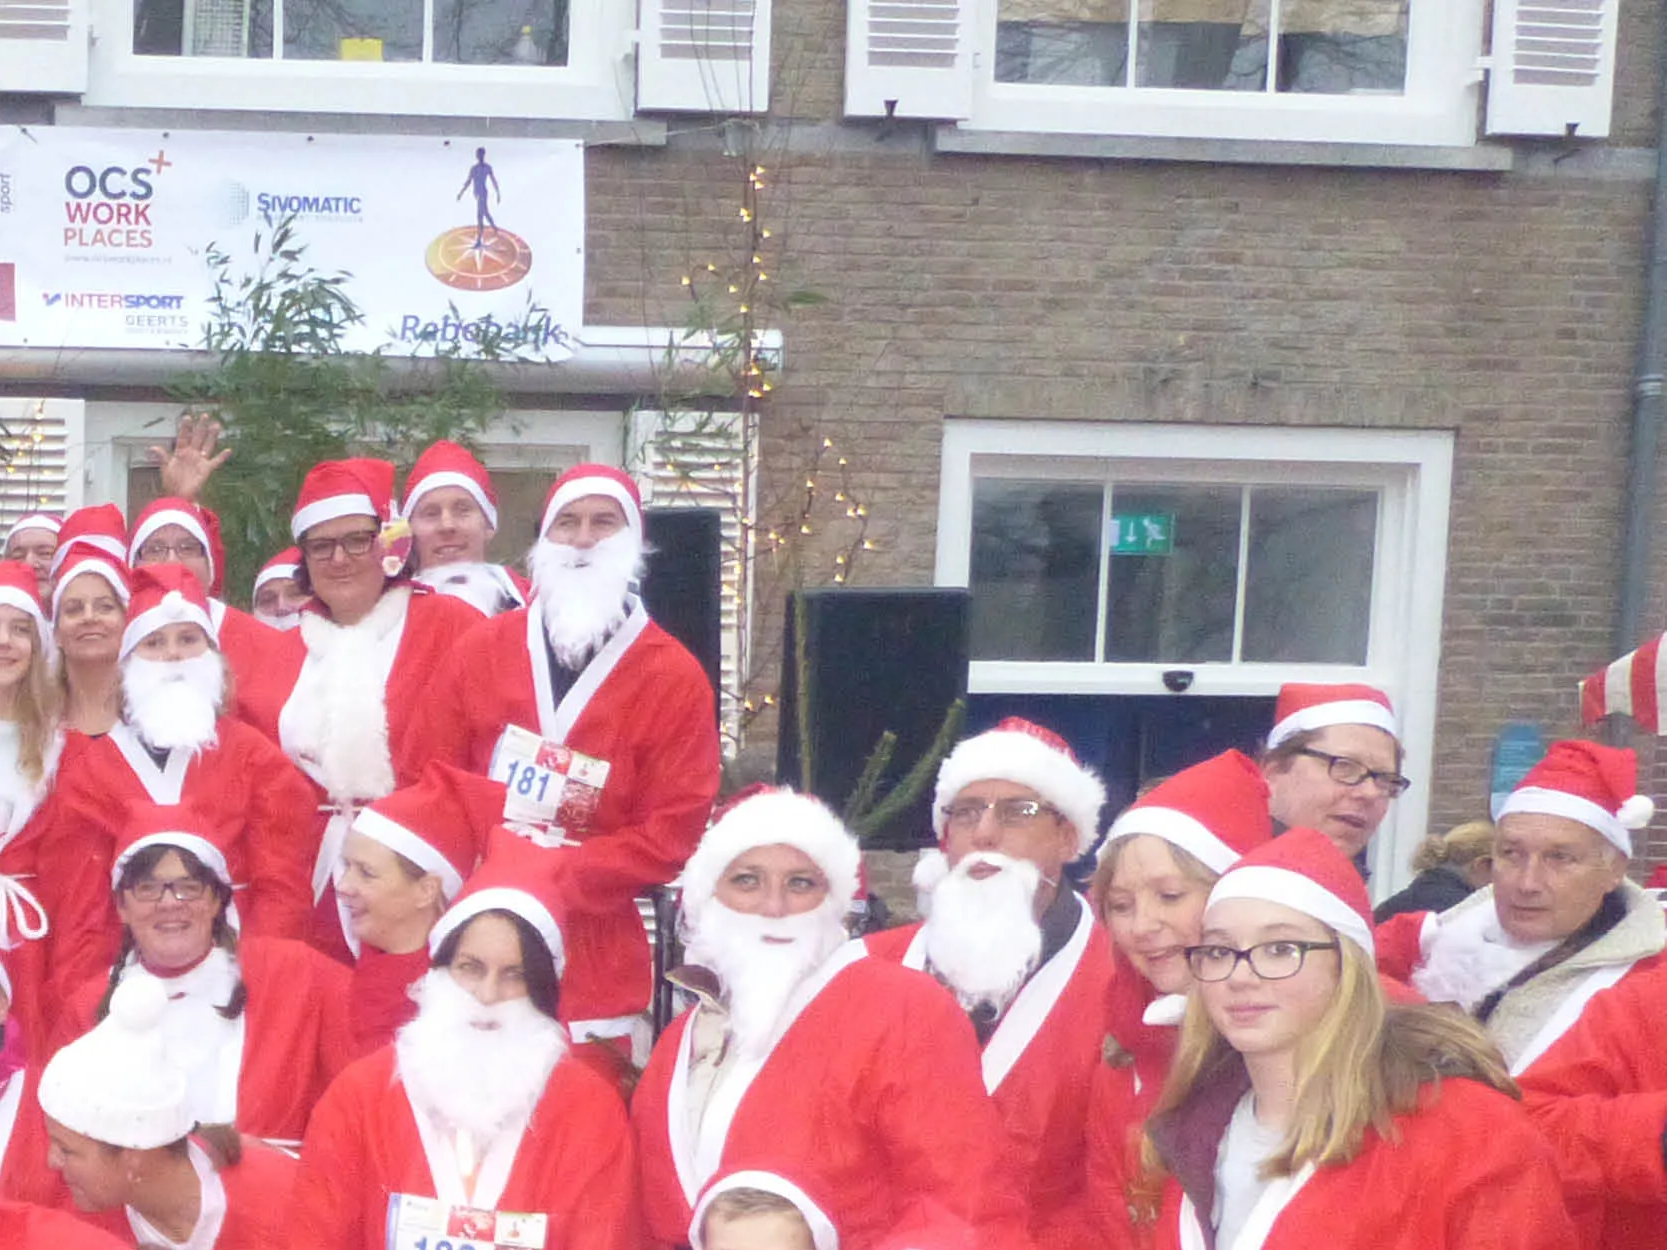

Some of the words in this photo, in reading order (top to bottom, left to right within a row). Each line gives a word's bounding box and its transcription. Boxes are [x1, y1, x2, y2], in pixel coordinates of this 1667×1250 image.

[65, 202, 152, 226] WORK
[257, 192, 362, 214] SIVOMATIC
[63, 227, 154, 249] PLACES
[65, 293, 184, 310] INTERSPORT
[125, 315, 189, 327] GEERTS
[506, 760, 551, 802] 181
